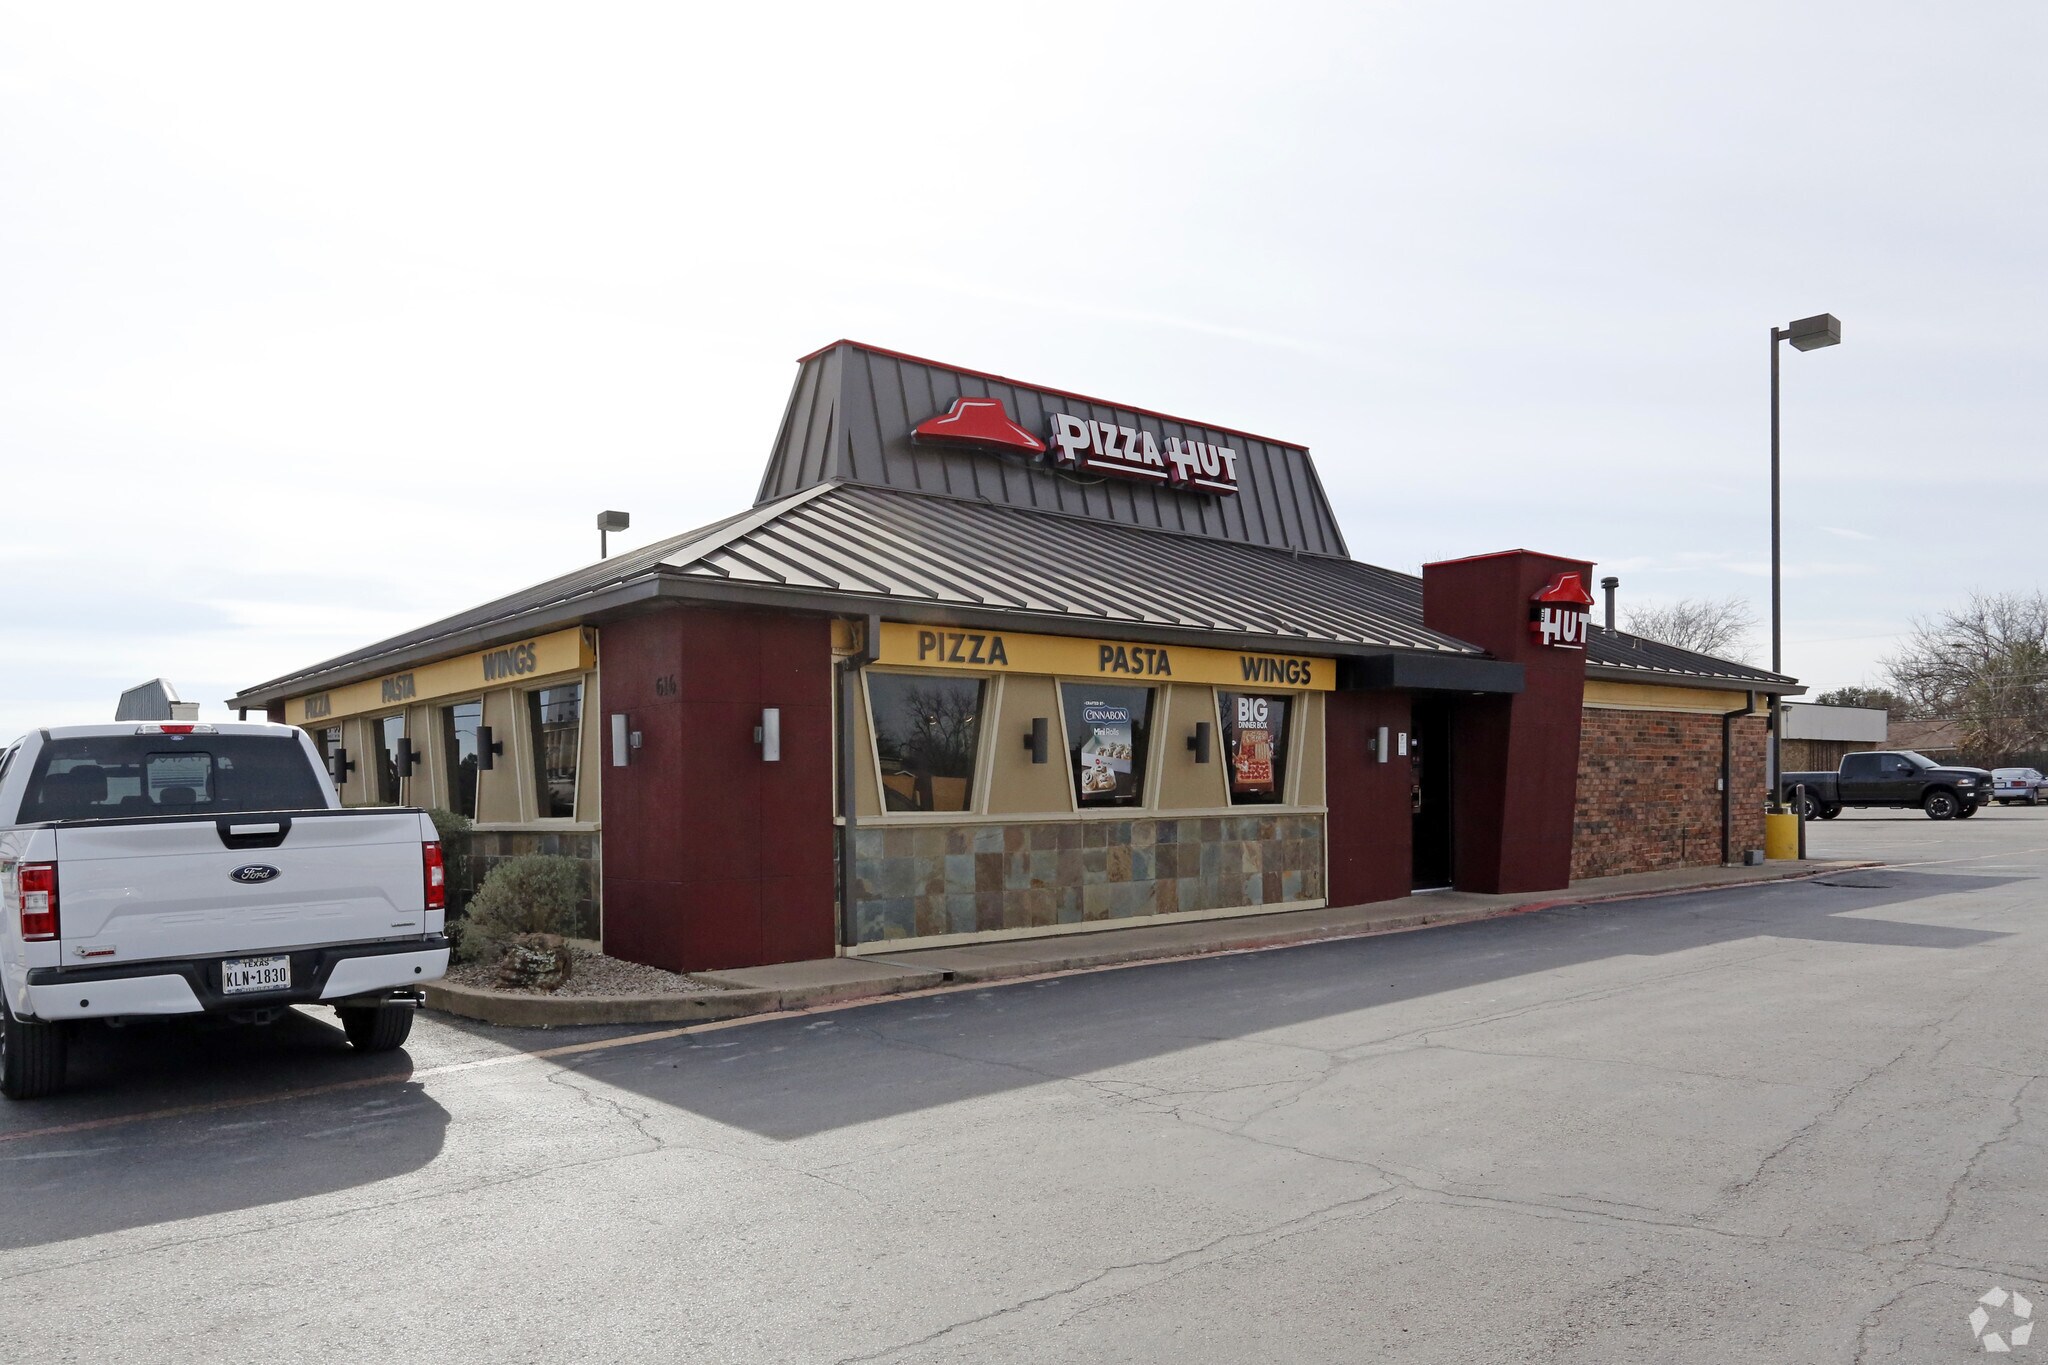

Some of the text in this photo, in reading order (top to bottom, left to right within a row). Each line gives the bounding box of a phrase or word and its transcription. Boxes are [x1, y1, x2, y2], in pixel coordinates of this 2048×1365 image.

[1053, 412, 1237, 481] PIZZA HUT
[1540, 607, 1592, 645] HUT
[918, 631, 1312, 685] PIZZA PASTA WINGS
[304, 642, 537, 720] PIZZA PASTA WINGS
[1086, 709, 1126, 720] CINNABON
[1238, 698, 1268, 721] BIG
[1094, 728, 1119, 736] Mini Rolls
[241, 867, 271, 880] Ford
[243, 960, 270, 968] TEXAS
